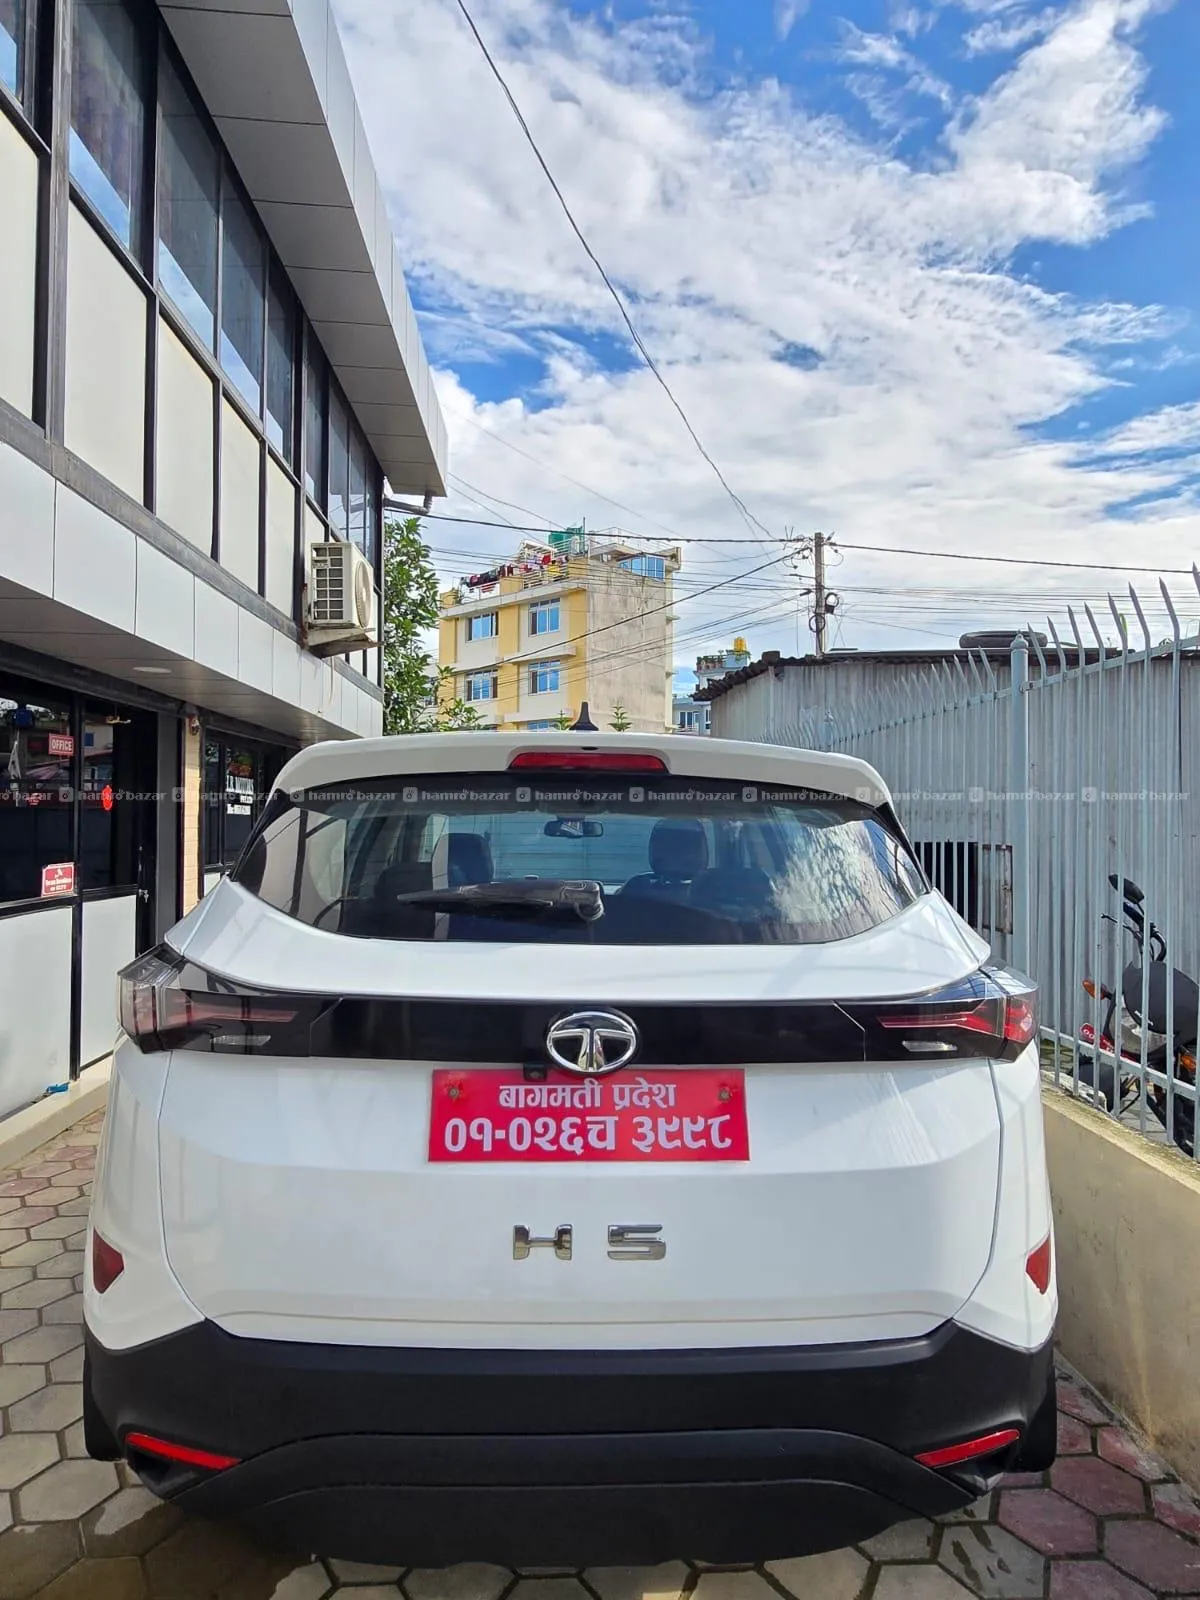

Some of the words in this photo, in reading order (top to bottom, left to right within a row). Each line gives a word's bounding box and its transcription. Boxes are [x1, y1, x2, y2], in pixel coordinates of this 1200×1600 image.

[51, 739, 72, 752] OFFICE
[499, 1077, 603, 1109] बागमती
[611, 1077, 677, 1111] प्रदेश
[444, 1115, 619, 1156] ०१-०२६च
